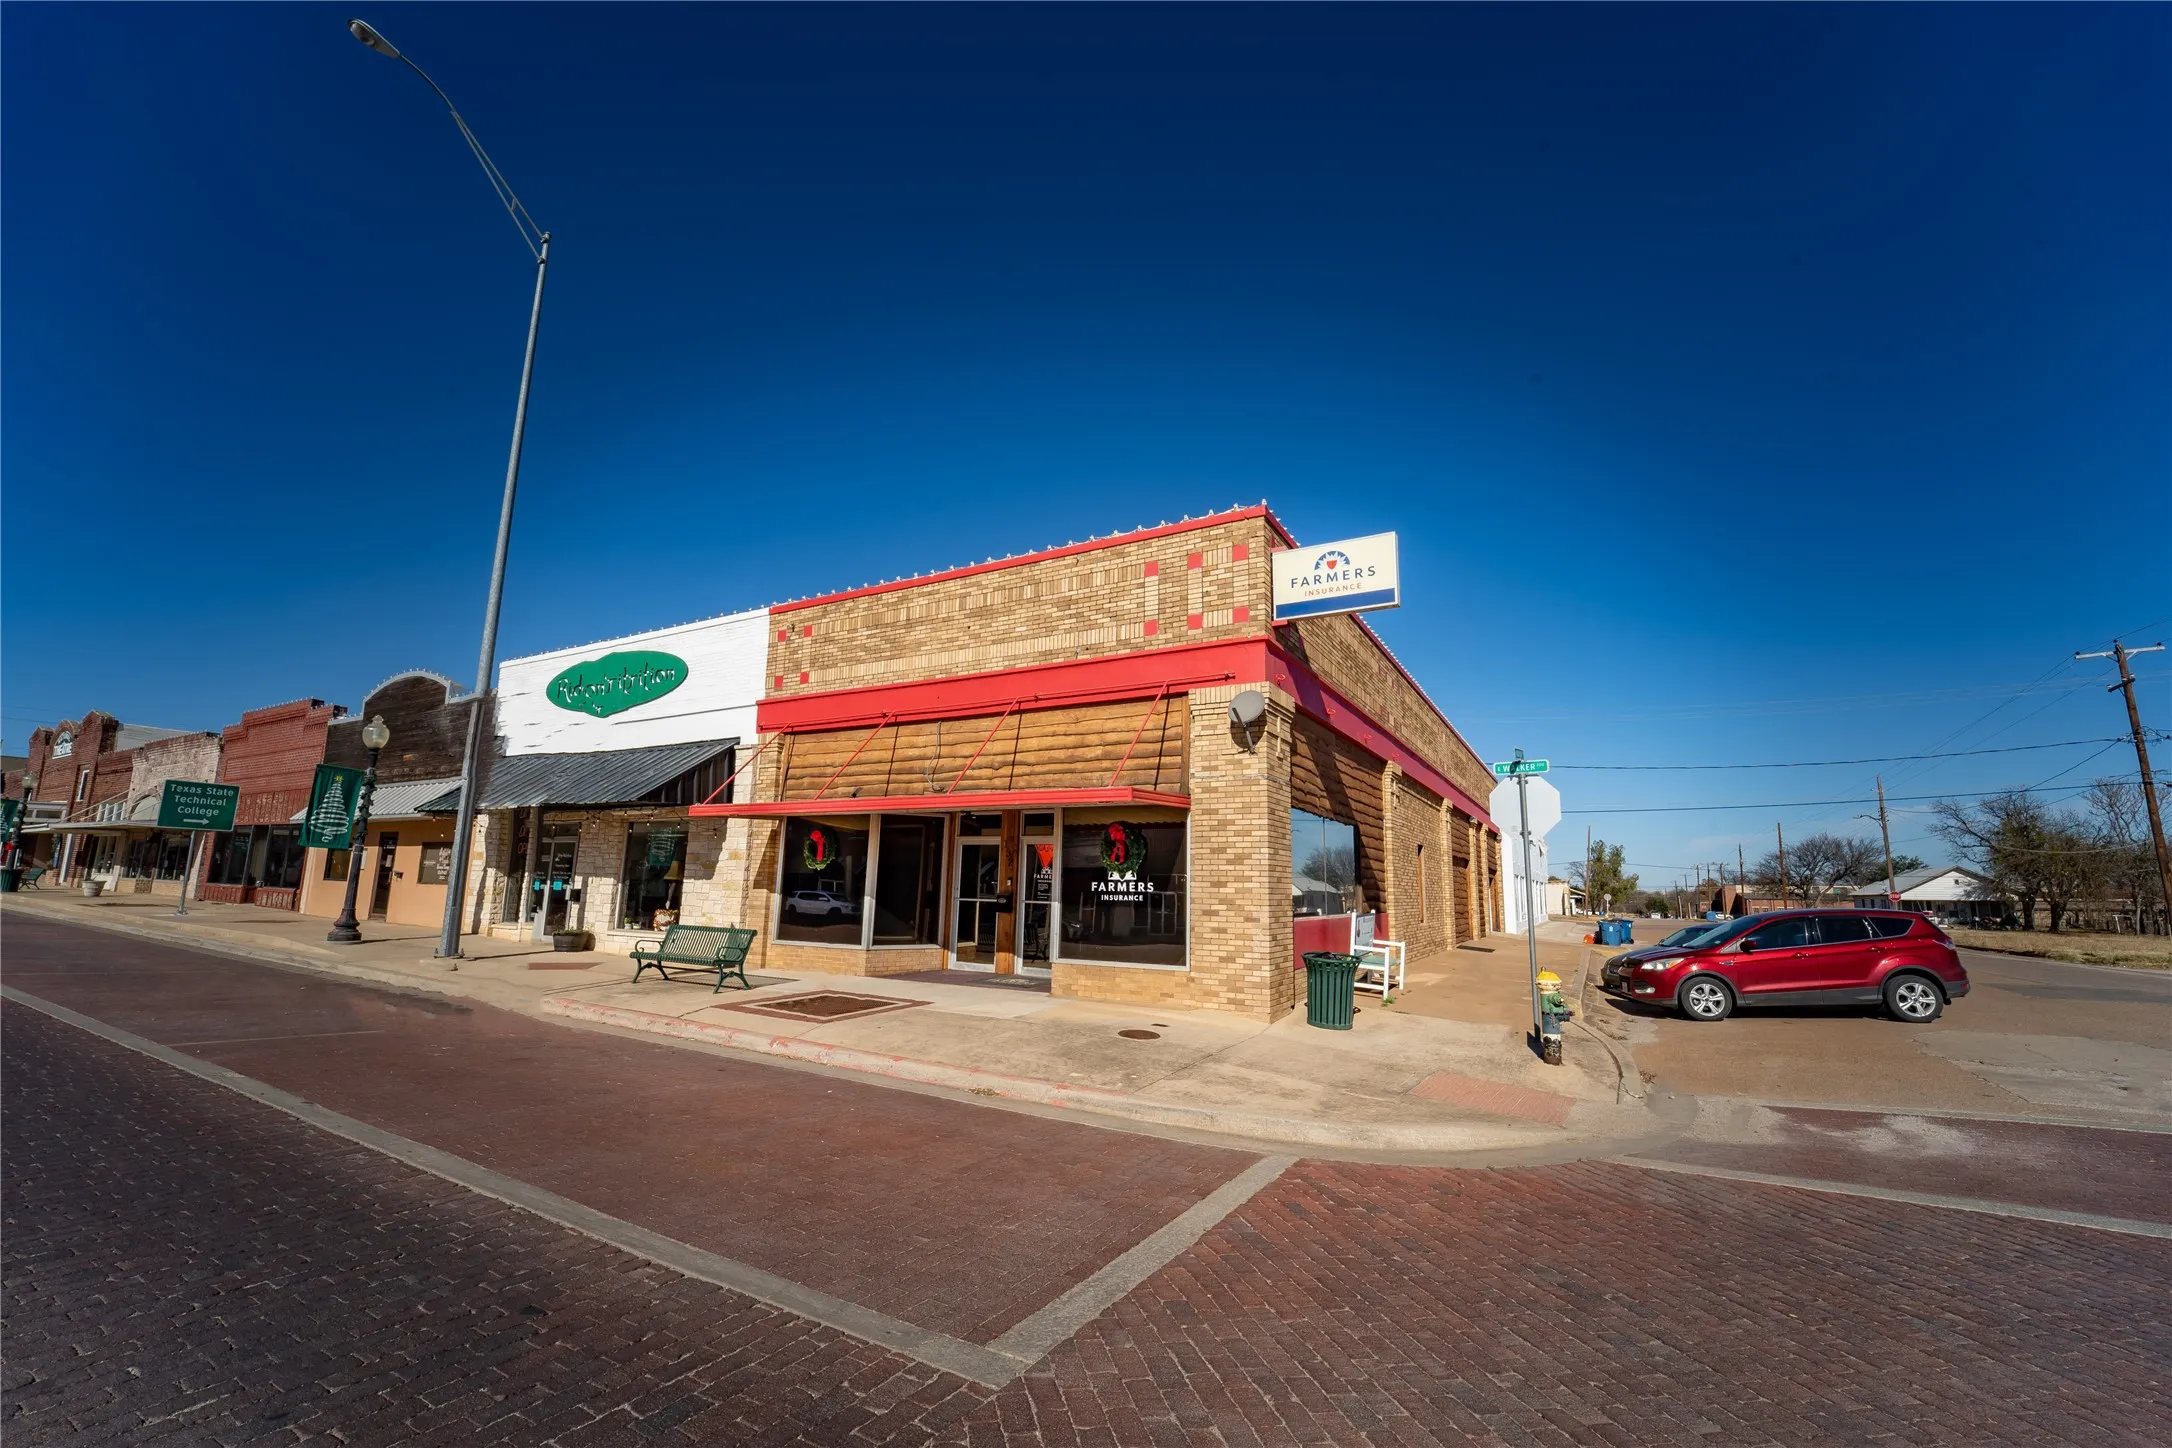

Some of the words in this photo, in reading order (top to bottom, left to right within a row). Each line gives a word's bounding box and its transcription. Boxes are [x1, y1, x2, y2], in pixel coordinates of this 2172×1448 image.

[1291, 565, 1376, 588] FARMERS
[1304, 582, 1362, 597] INSURANCE
[1502, 763, 1536, 772] WALKER
[170, 783, 202, 794] Texas
[206, 787, 234, 797] State
[174, 794, 227, 806] Technical
[177, 805, 220, 817] College
[1091, 881, 1154, 893] FARMERS
[1101, 894, 1144, 902] INSURANCE
